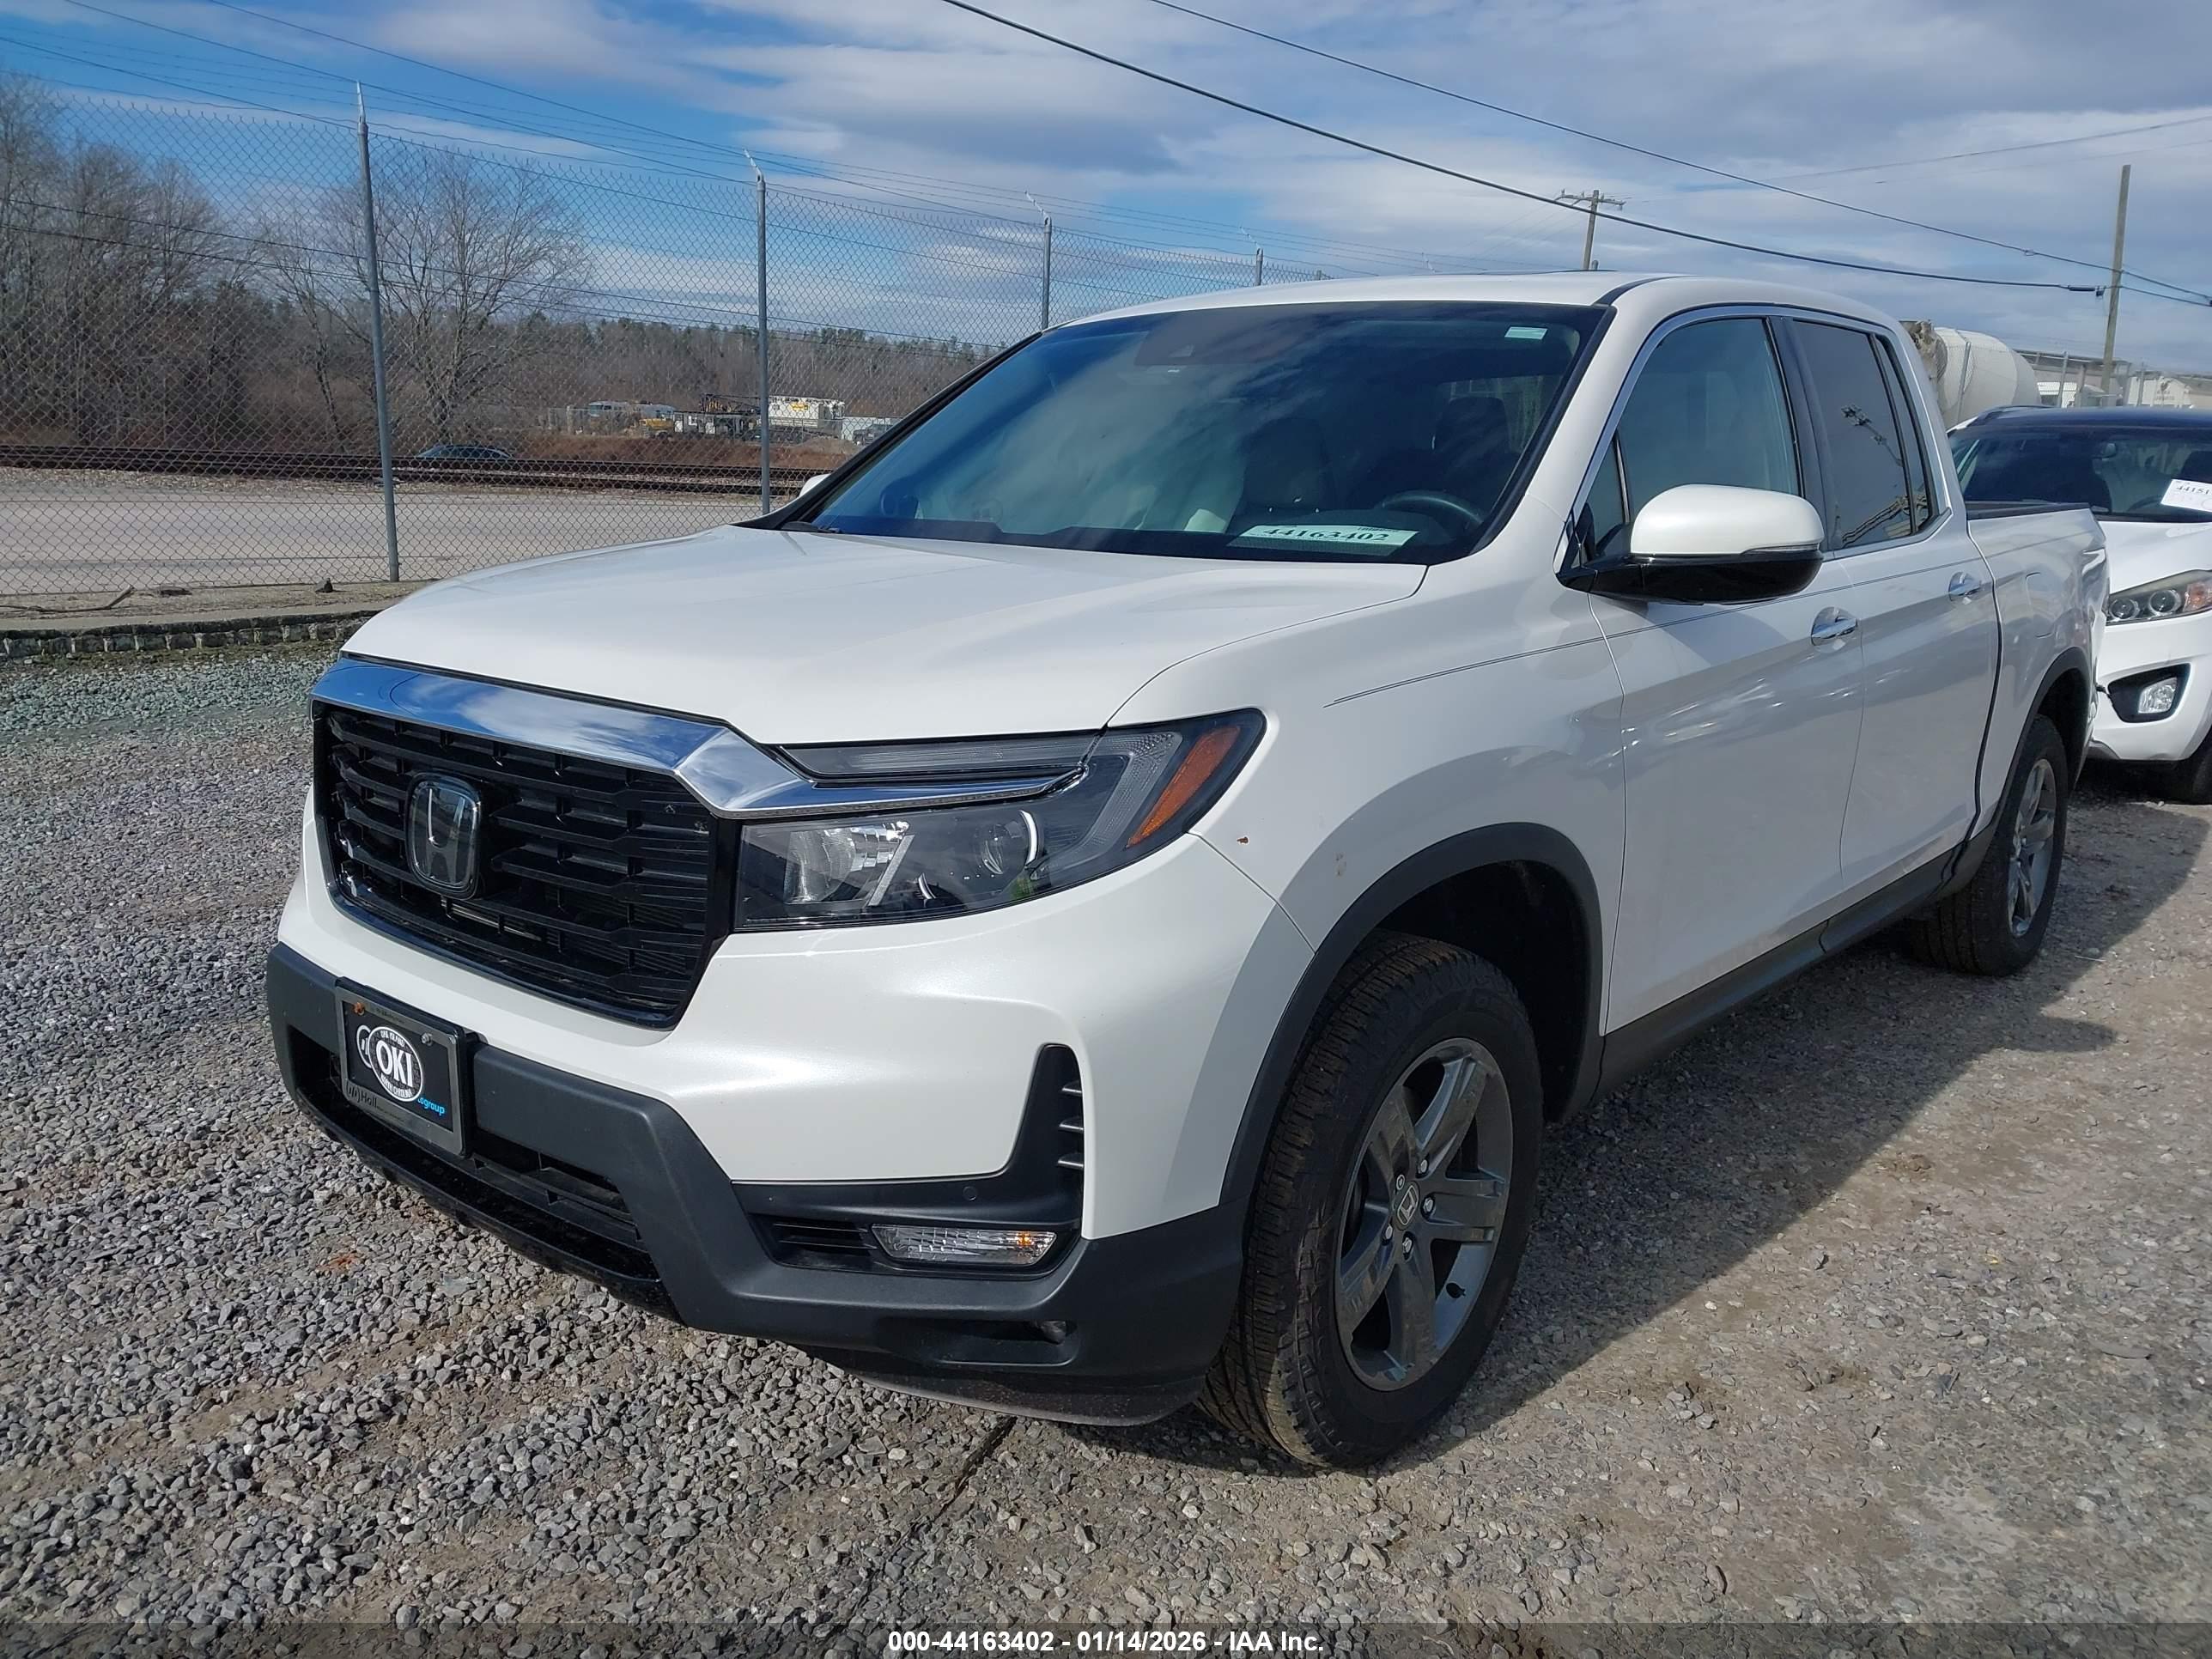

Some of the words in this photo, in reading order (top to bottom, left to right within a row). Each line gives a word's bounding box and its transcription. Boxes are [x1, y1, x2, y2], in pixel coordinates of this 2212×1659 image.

[2175, 485, 2212, 495] 44151
[1264, 528, 1390, 542] 44163402
[375, 1039, 413, 1088] OKI
